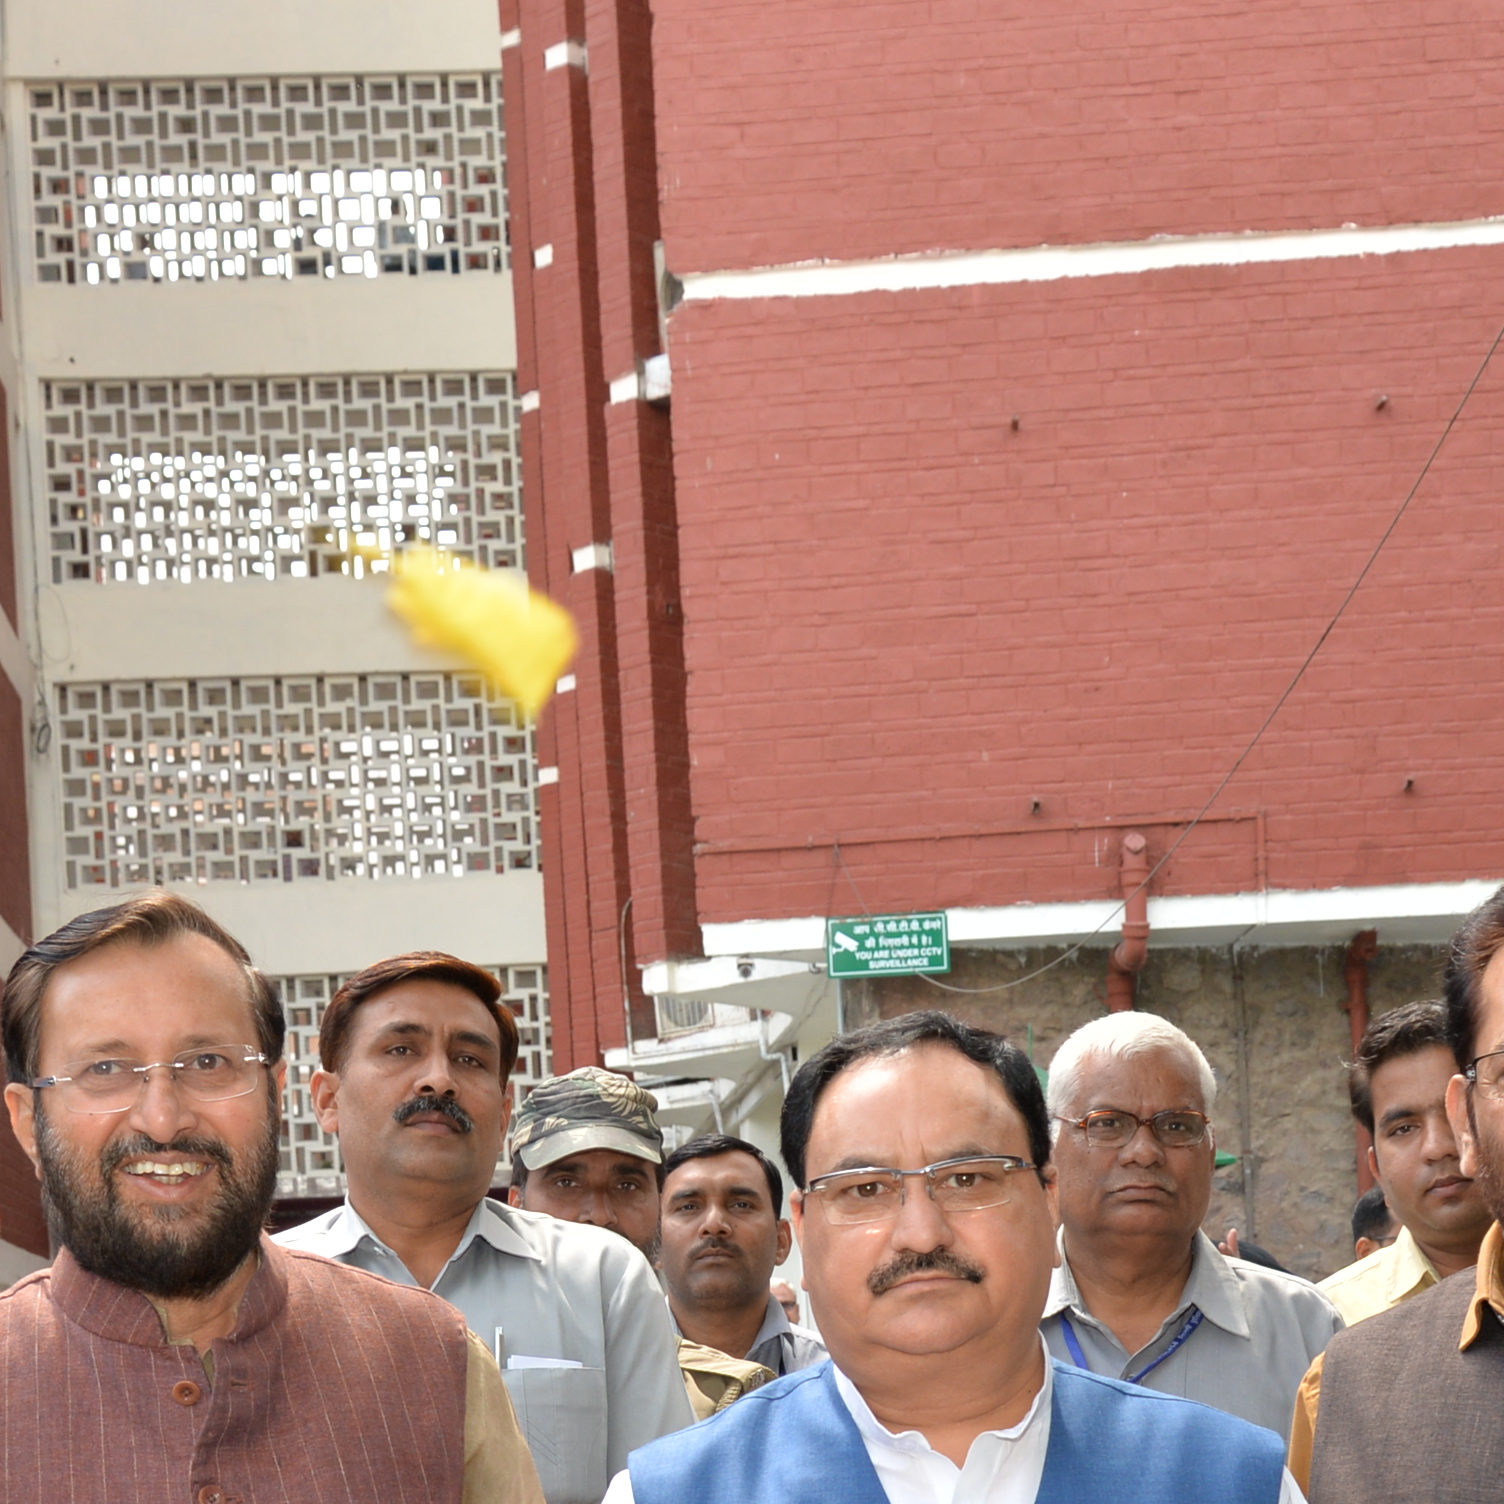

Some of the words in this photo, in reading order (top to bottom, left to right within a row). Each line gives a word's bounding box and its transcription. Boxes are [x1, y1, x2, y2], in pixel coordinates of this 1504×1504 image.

[855, 951, 872, 960] YOU
[873, 950, 890, 959] ARE
[891, 948, 919, 958] UNDER
[921, 947, 942, 956] CCTV
[869, 958, 929, 969] SURVEILLANCE
